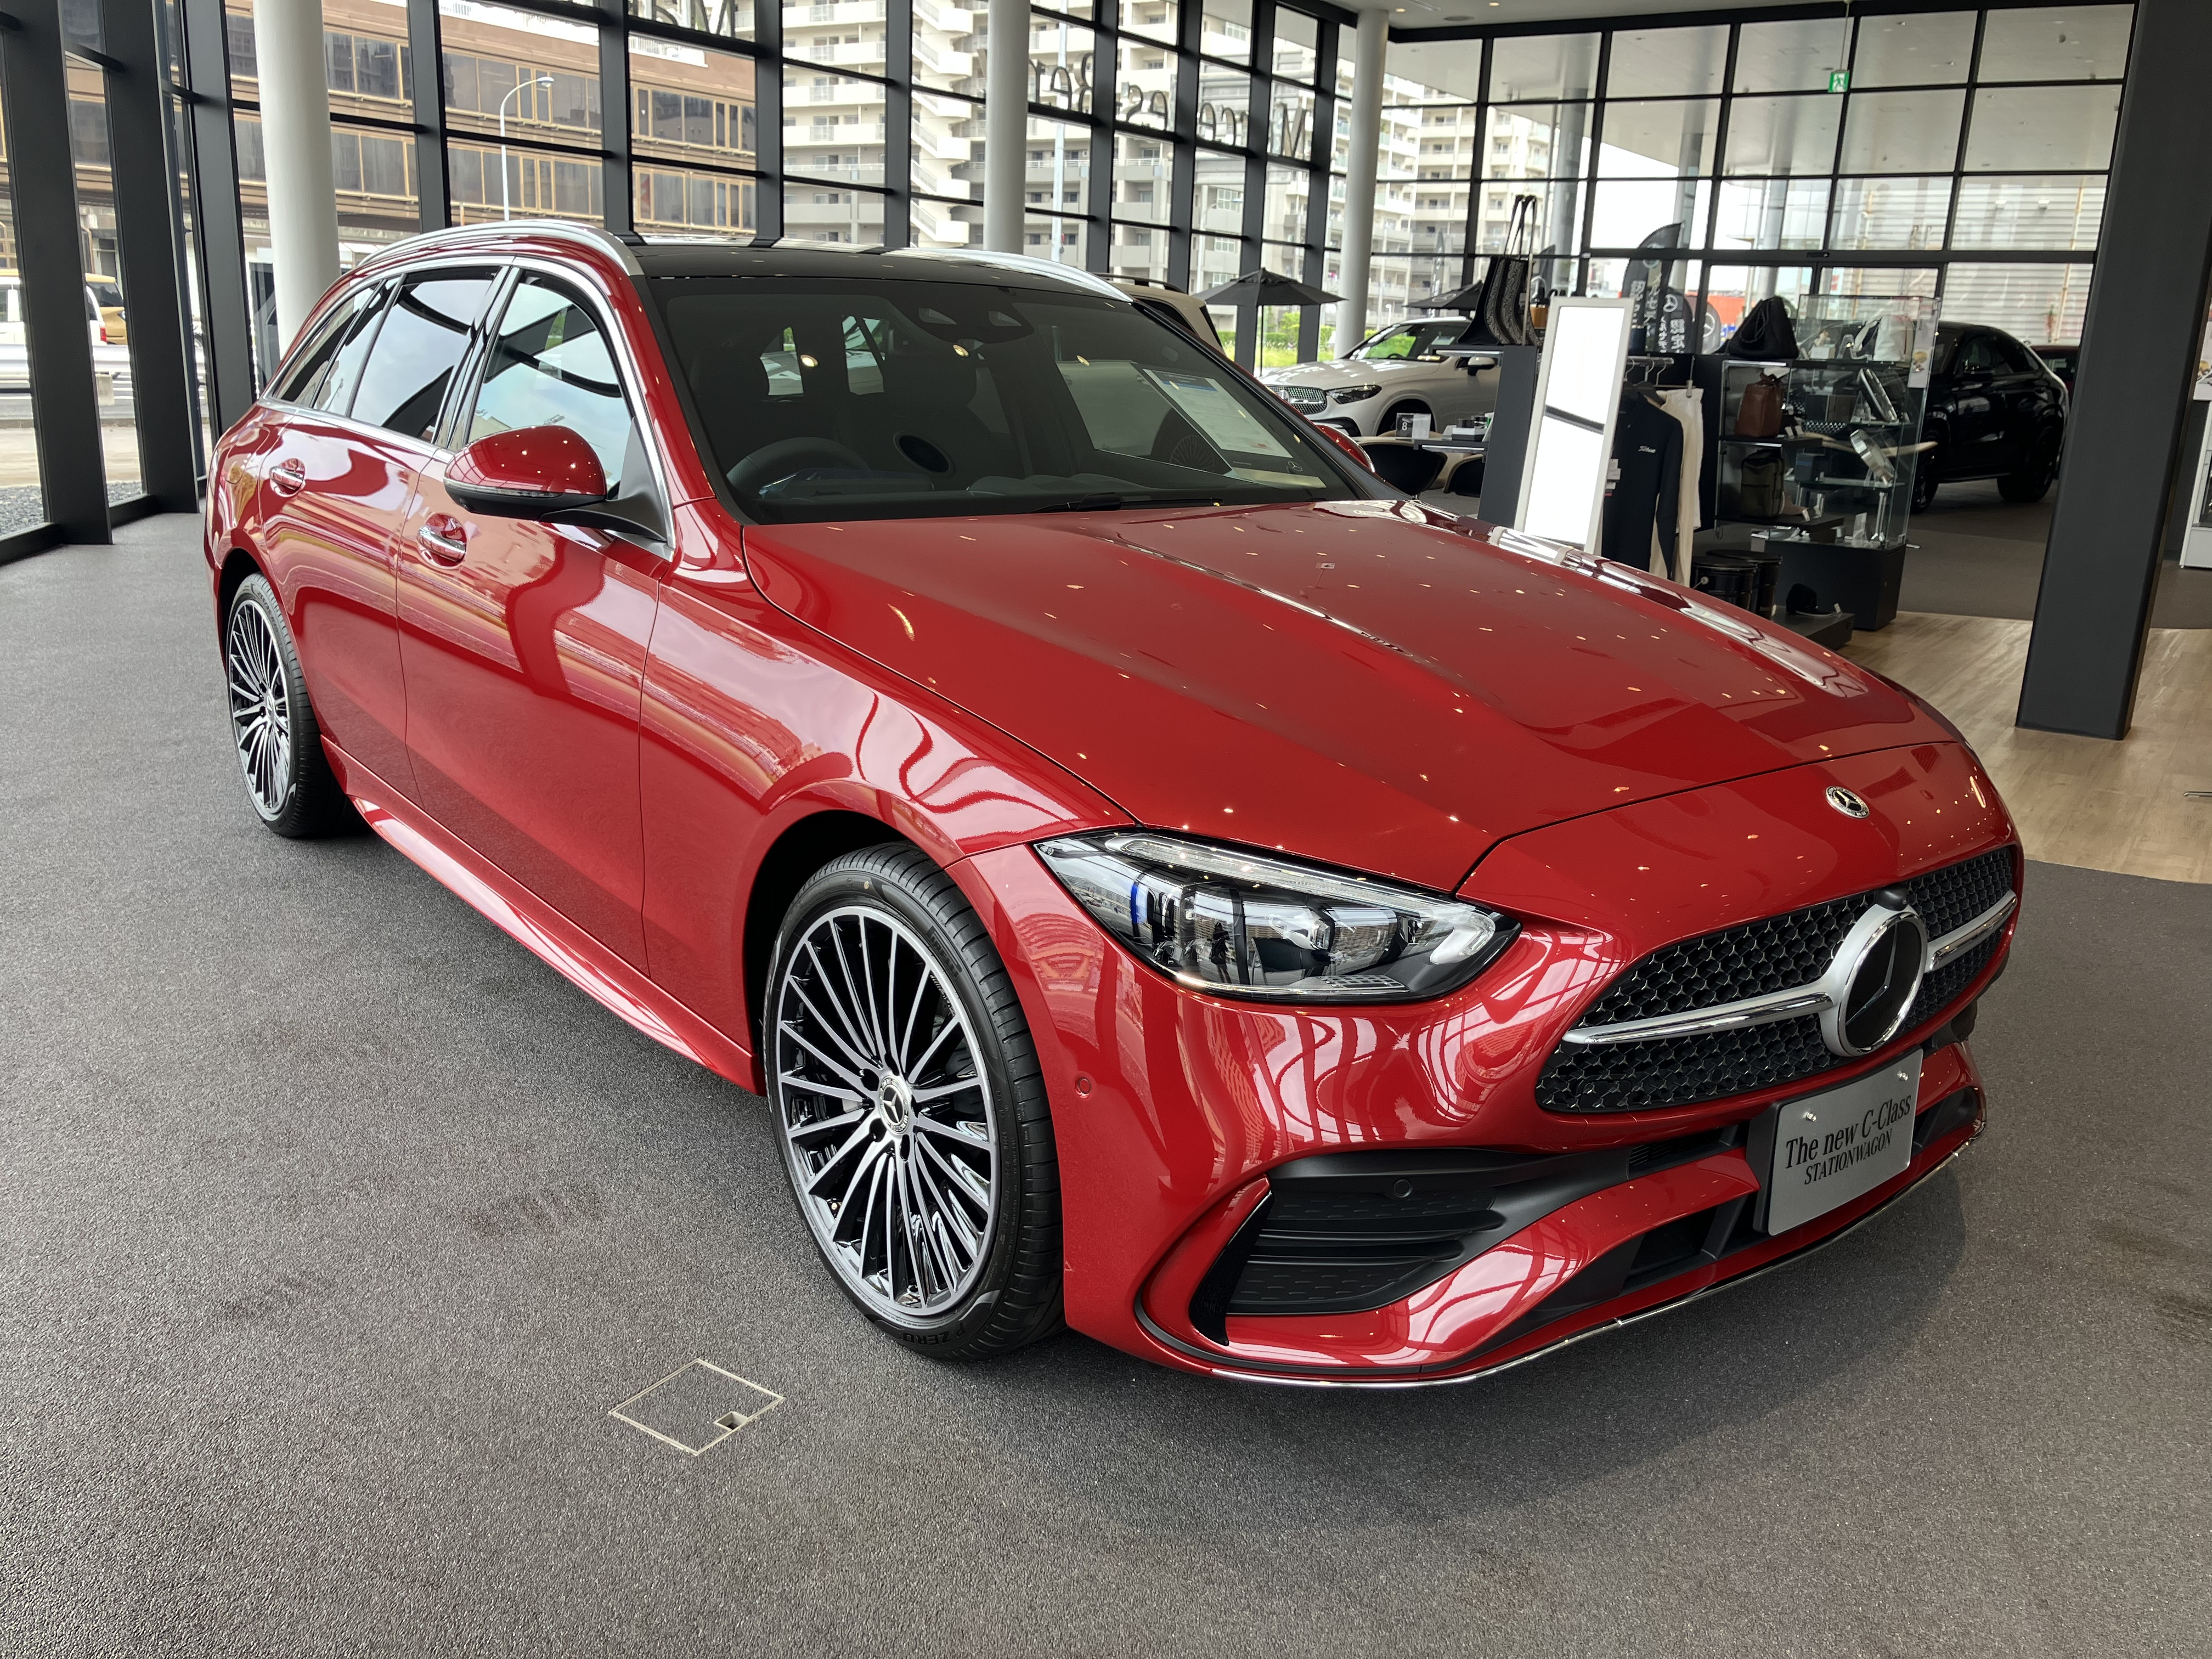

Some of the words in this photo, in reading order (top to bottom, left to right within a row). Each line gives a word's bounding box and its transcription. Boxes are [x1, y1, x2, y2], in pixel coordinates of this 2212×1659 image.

[1402, 422, 1408, 431] 8
[1786, 1136, 1819, 1169] The
[1822, 1123, 1859, 1155] new
[1862, 1094, 1911, 1138] C-Class
[1804, 1128, 1893, 1185] STATIONWAGON
[902, 1330, 952, 1345] ZERO
